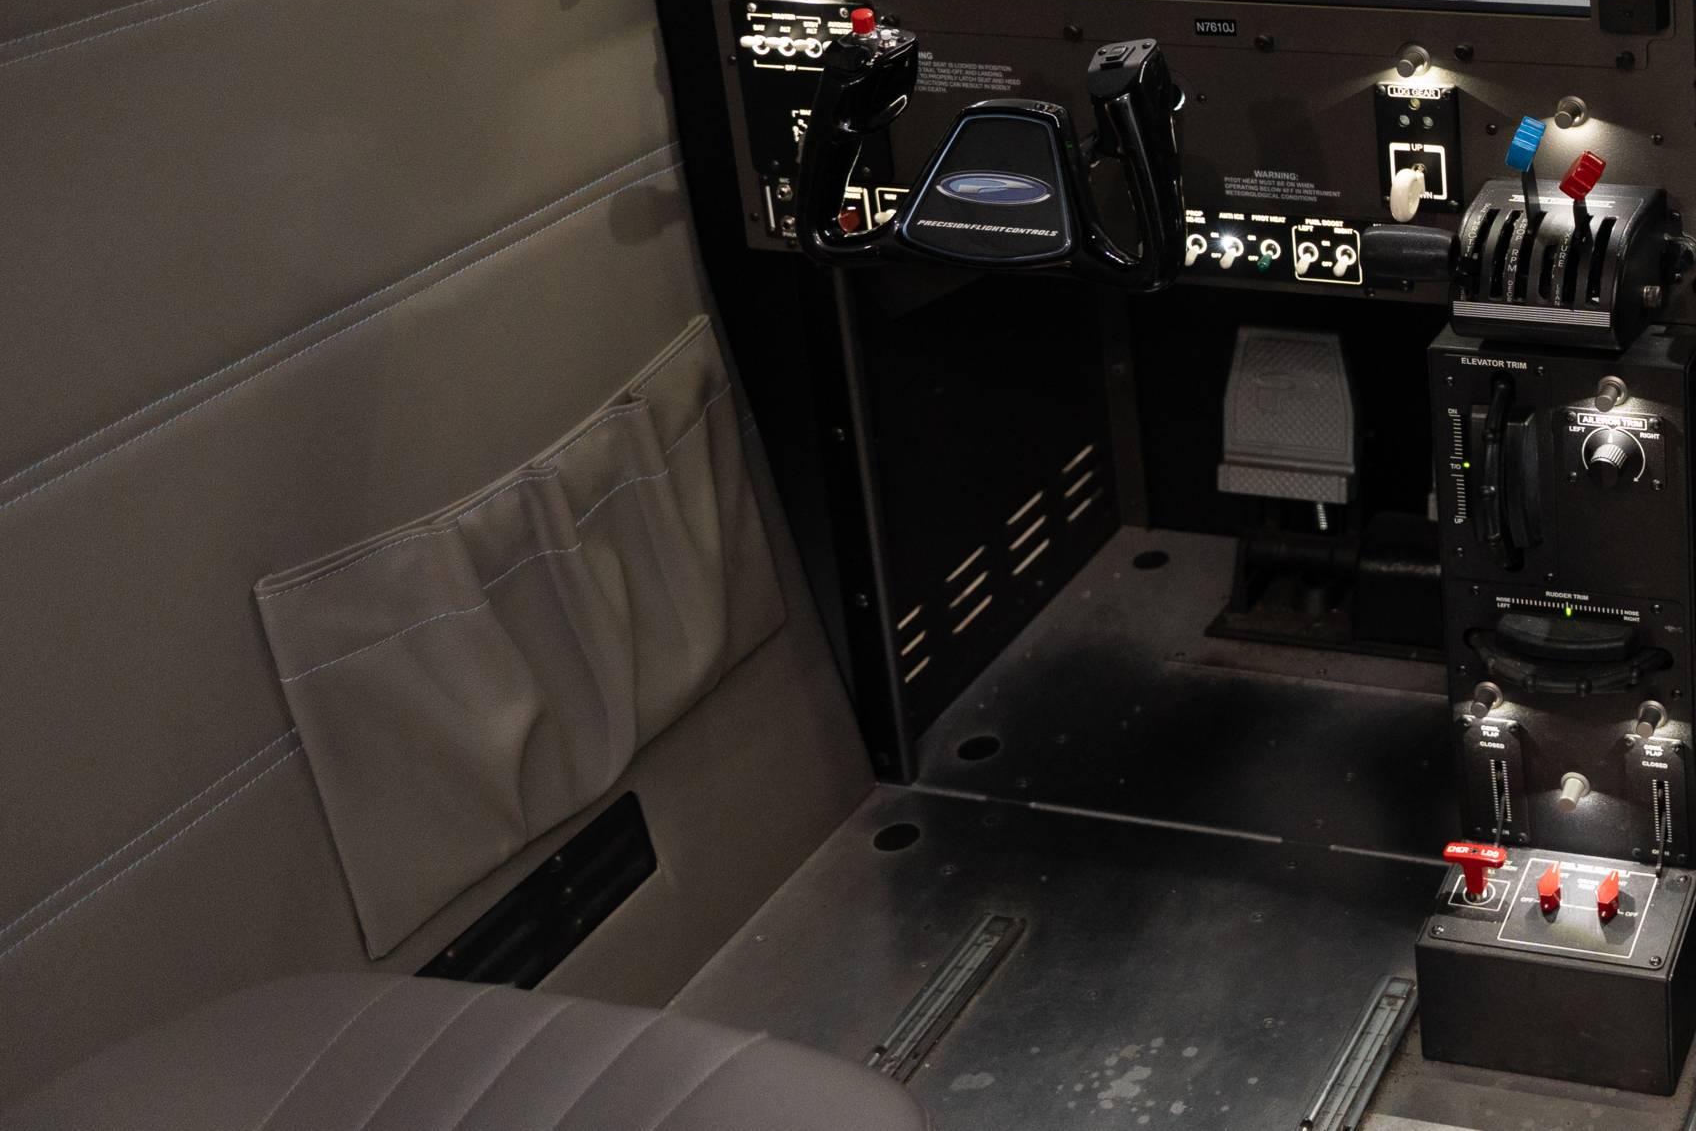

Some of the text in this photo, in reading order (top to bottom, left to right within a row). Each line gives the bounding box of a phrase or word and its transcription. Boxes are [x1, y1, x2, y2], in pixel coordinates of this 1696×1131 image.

[1196, 21, 1235, 33] N7610J
[1412, 89, 1436, 98] GEAR
[1411, 143, 1424, 152] UP
[917, 219, 1059, 237] PRECISION FLIGHT CONTROLS
[1461, 357, 1527, 369] ELEVATOR TRIM
[1582, 416, 1643, 428] AILERON TRIM
[1569, 425, 1585, 433] LEFT
[1639, 432, 1660, 440] RIGHT
[1545, 591, 1589, 601] RUDDER TRIM
[1479, 741, 1505, 749] CLOSED
[1642, 760, 1668, 769] CLOSED
[1480, 848, 1500, 858] LDG
